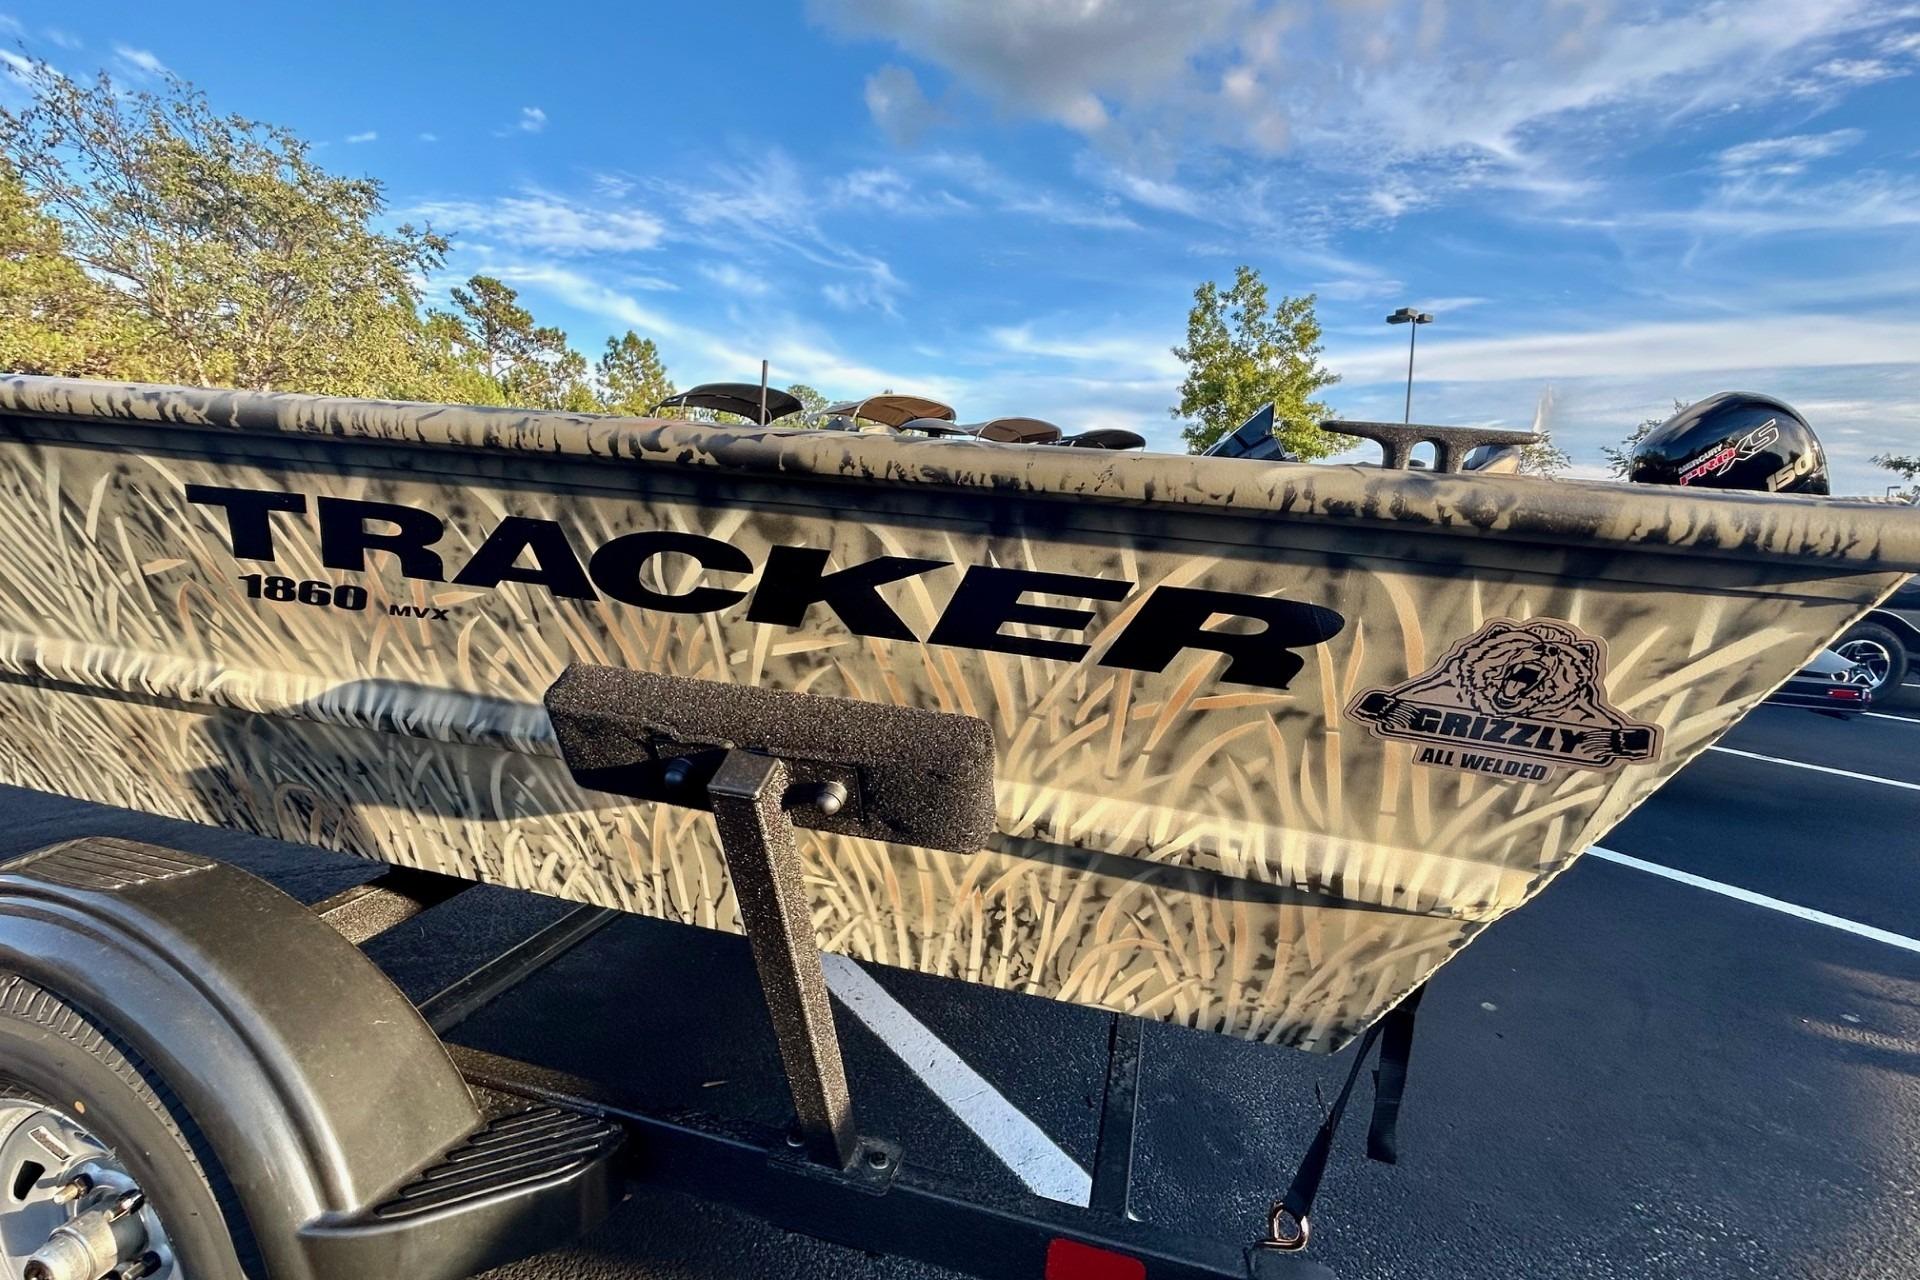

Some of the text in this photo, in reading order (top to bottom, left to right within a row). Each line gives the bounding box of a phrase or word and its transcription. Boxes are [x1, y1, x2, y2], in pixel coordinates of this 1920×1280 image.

[1679, 443, 1723, 474] MERCURY
[1766, 454, 1815, 492] 150
[185, 483, 1344, 689] TRACKER
[238, 574, 449, 621] 1860 MVX
[1409, 707, 1586, 754] GRIZZLY
[1419, 748, 1548, 781] ALL WELDED
